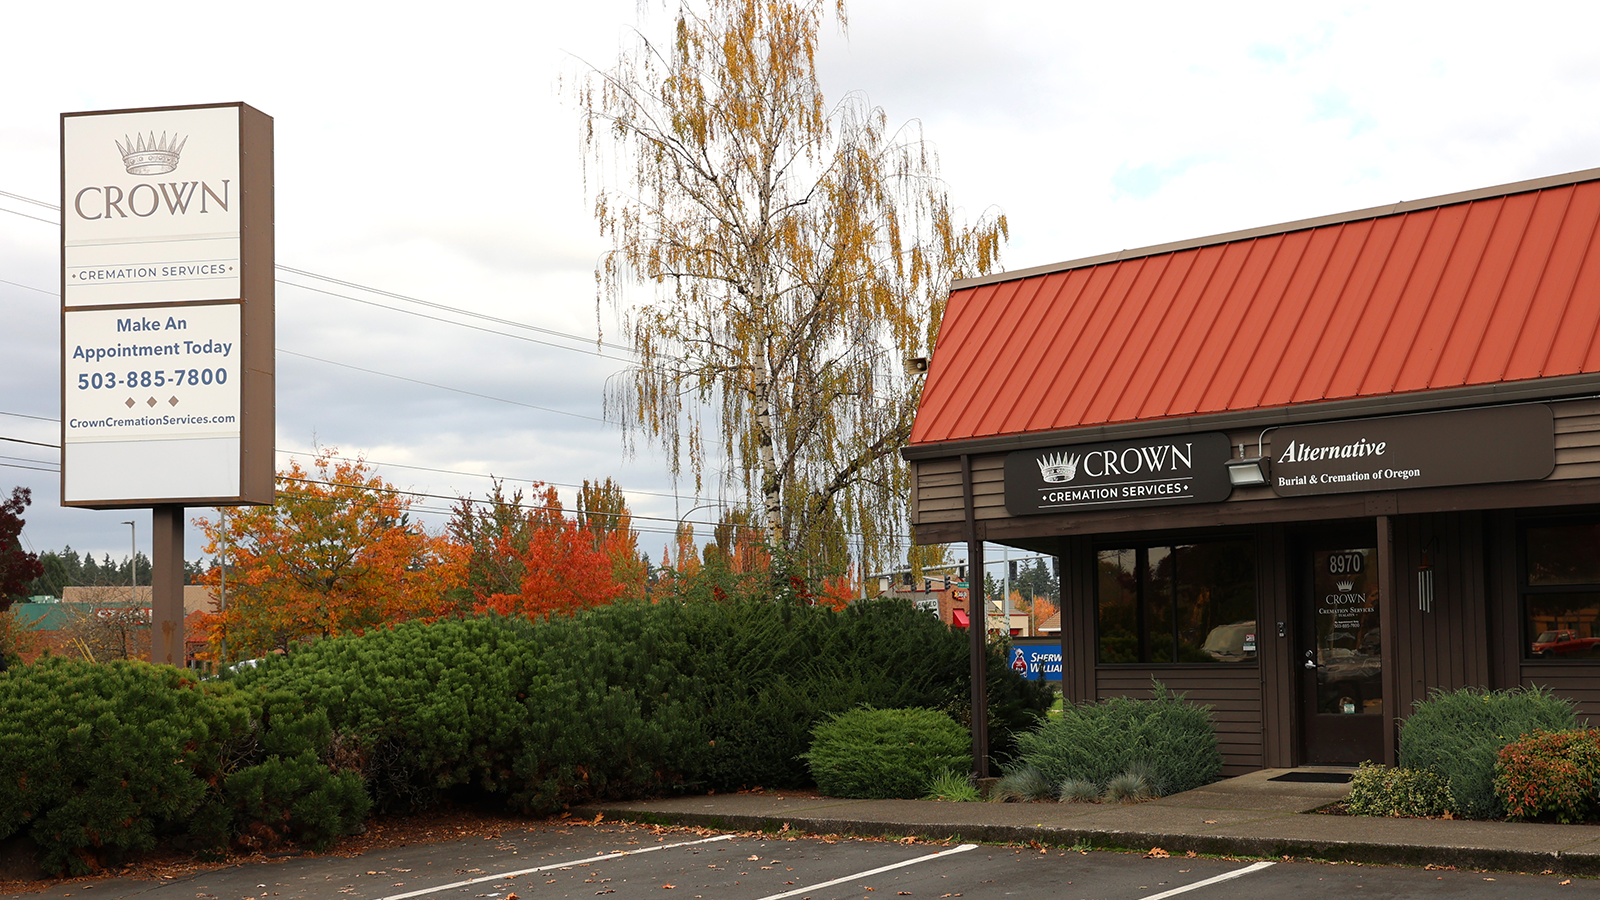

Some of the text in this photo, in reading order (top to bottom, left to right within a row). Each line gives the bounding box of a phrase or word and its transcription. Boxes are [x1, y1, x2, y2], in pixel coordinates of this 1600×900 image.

[74, 179, 230, 220] CROWN
[79, 263, 226, 281] CREMATION SERVICES
[116, 316, 187, 332] Make An
[72, 338, 232, 362] Appointment Today
[77, 367, 228, 390] 503-885-7800
[69, 413, 236, 428] CrownCremationServices.com
[1083, 443, 1193, 477] CROWN
[1277, 438, 1386, 463] Alternative
[1278, 468, 1421, 486] Burial & Cremation of Oregon
[1049, 483, 1182, 502] CREMATION SERVICES
[1330, 554, 1360, 573] 8970
[1325, 593, 1366, 605] CROWN
[1030, 663, 1063, 673] WLLIA
